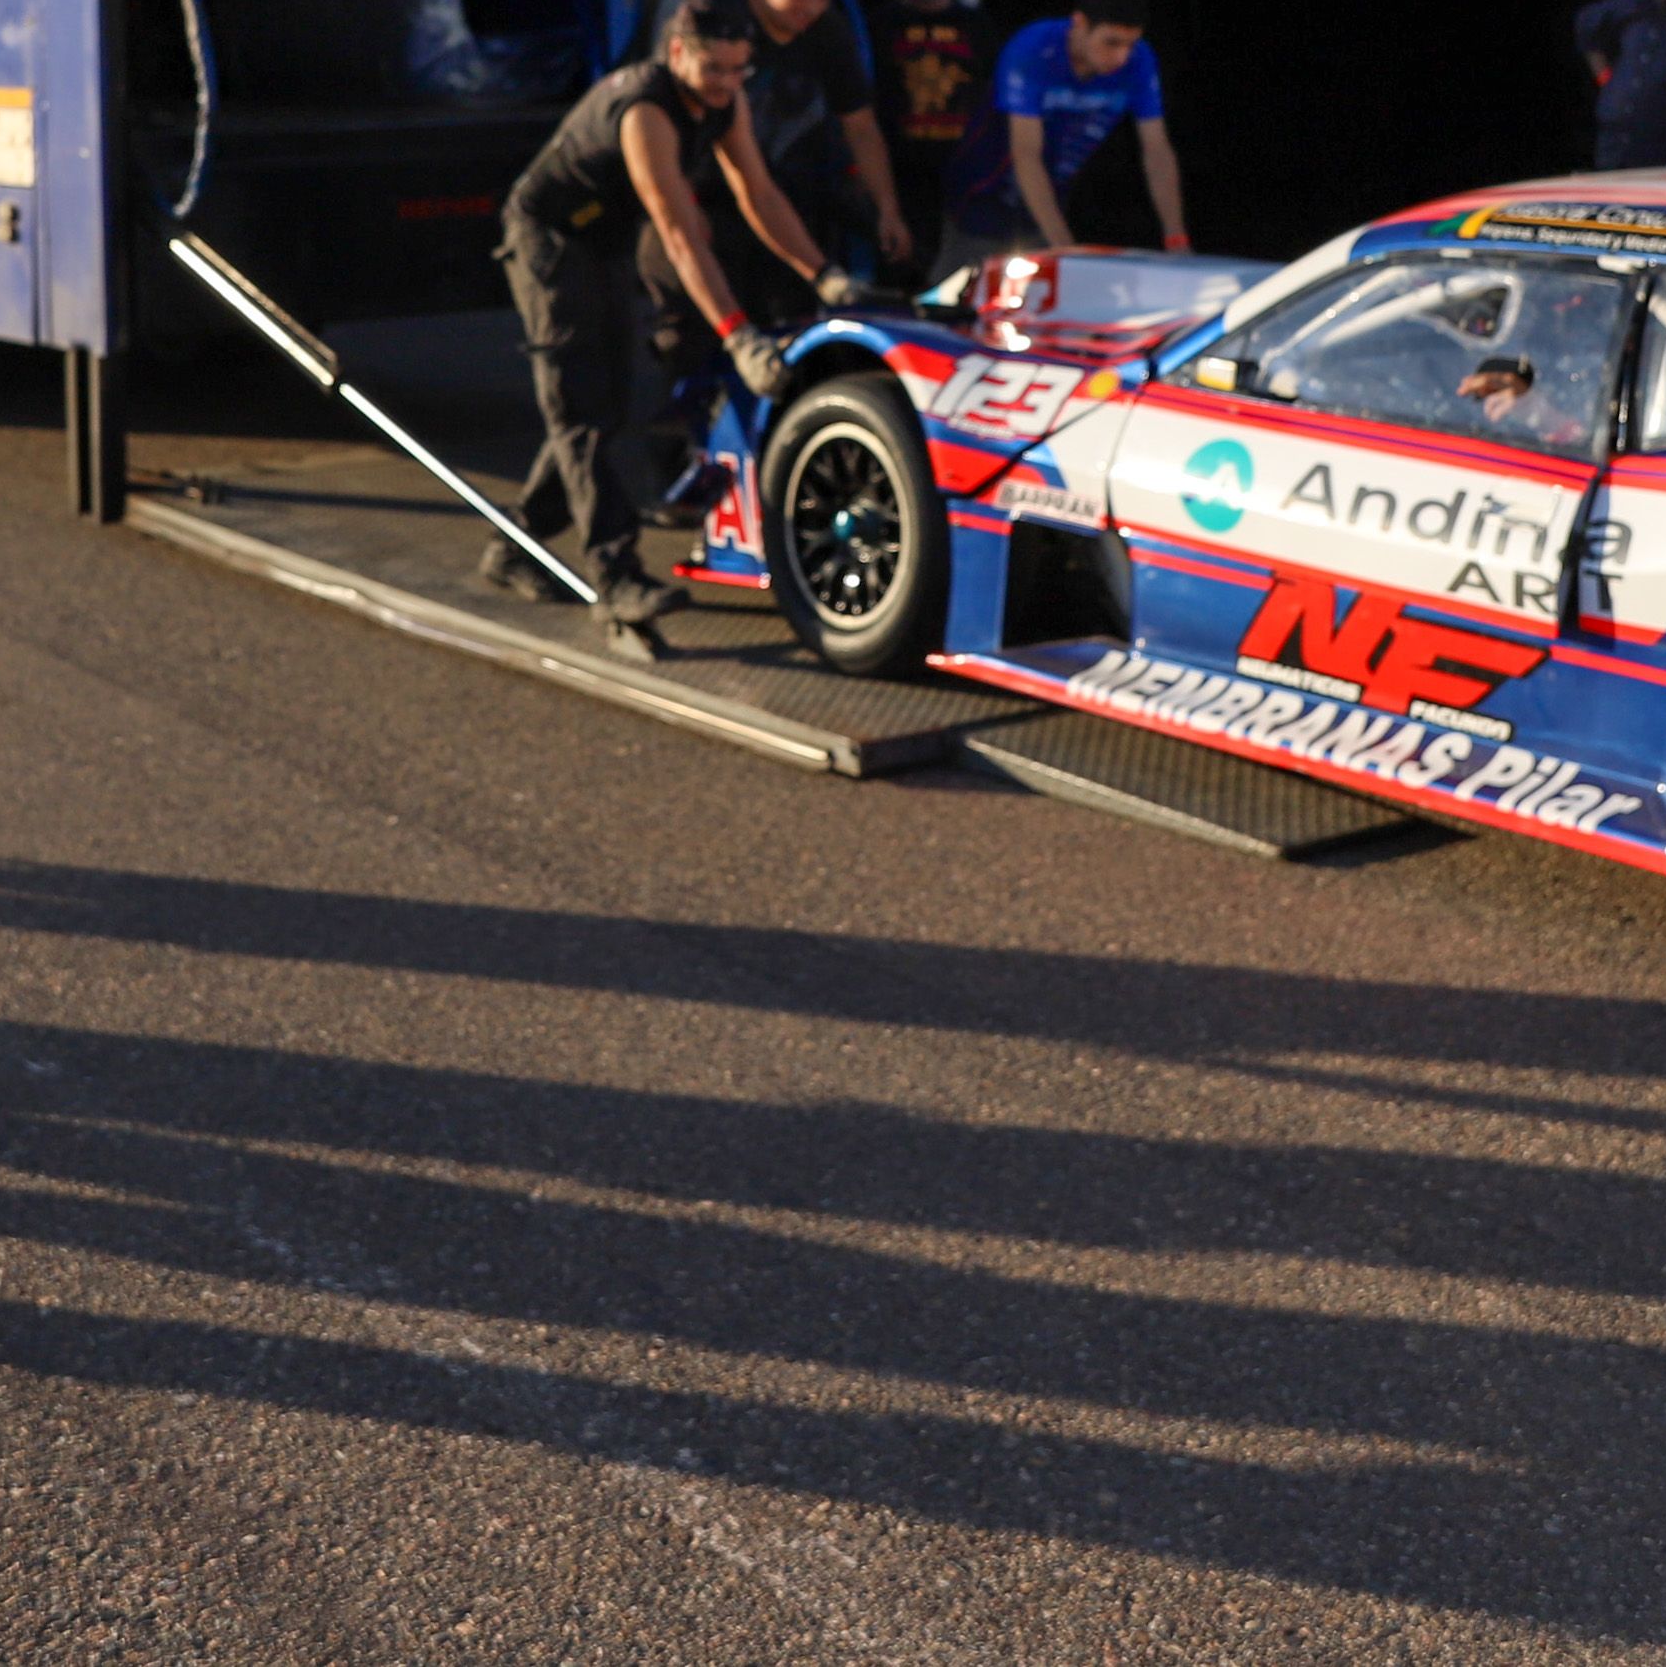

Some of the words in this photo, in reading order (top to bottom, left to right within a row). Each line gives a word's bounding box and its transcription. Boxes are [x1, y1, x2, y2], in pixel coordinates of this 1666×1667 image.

[930, 353, 1085, 437] 123
[1280, 464, 1635, 565] Andina
[1446, 561, 1624, 615] ART
[1237, 575, 1549, 716] NF
[1064, 648, 1474, 787] MEMBRANAS
[1454, 744, 1642, 834] Pilar
